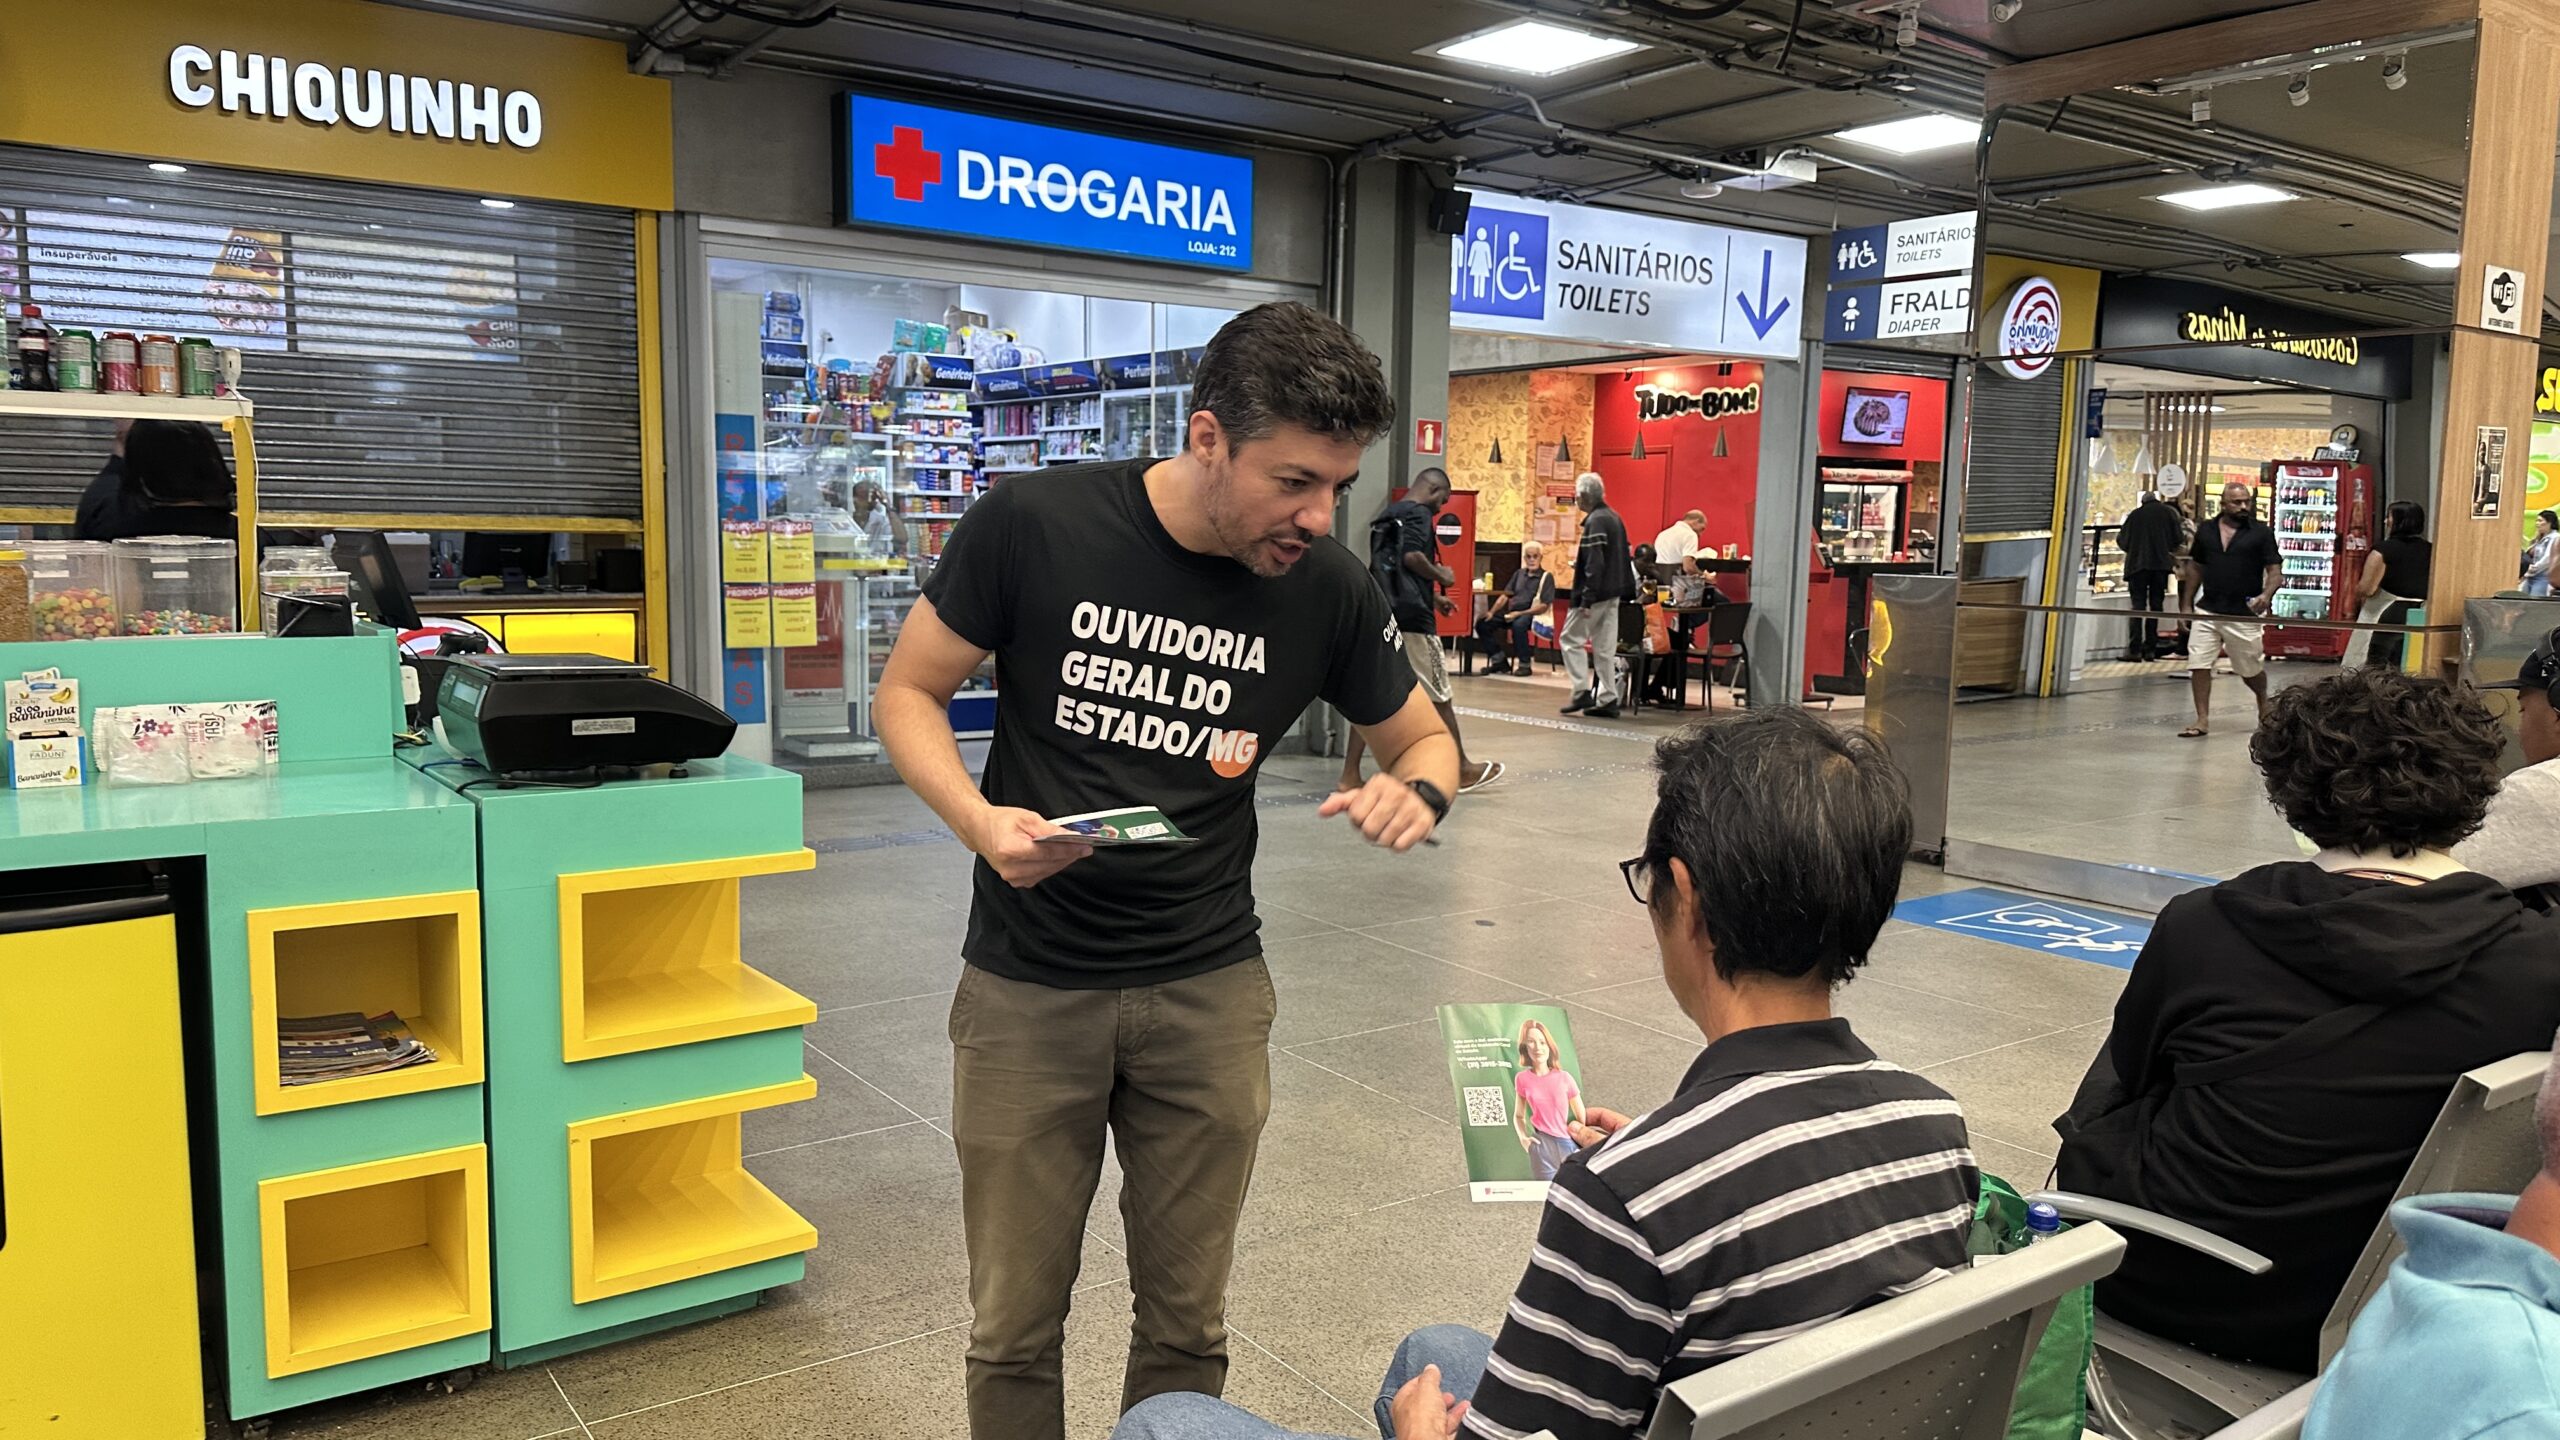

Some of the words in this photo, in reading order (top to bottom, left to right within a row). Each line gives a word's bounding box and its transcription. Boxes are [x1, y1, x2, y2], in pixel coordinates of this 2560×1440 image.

[168, 43, 544, 149] CHIQUINHO
[958, 148, 1237, 237] DROGARIA
[1188, 241, 1218, 255] LOJA:
[1219, 243, 1237, 257] 212
[1896, 248, 1943, 264] TOILETS
[1557, 239, 1714, 285] SANITÁRIOS
[1557, 283, 1651, 316] TOILETS
[1887, 317, 1941, 334] DIAPER
[726, 586, 769, 598] PROMOÇÃO
[773, 586, 815, 597] PROMOÇÃO
[1070, 600, 1266, 675] OUVIDORIA
[1061, 650, 1175, 706] GERAL
[1179, 673, 1232, 715] DO
[9, 705, 76, 723] Bananinha
[1055, 694, 1259, 763] ESTADO/MG
[29, 751, 65, 759] FADUNI
[17, 770, 62, 783] Bananinha
